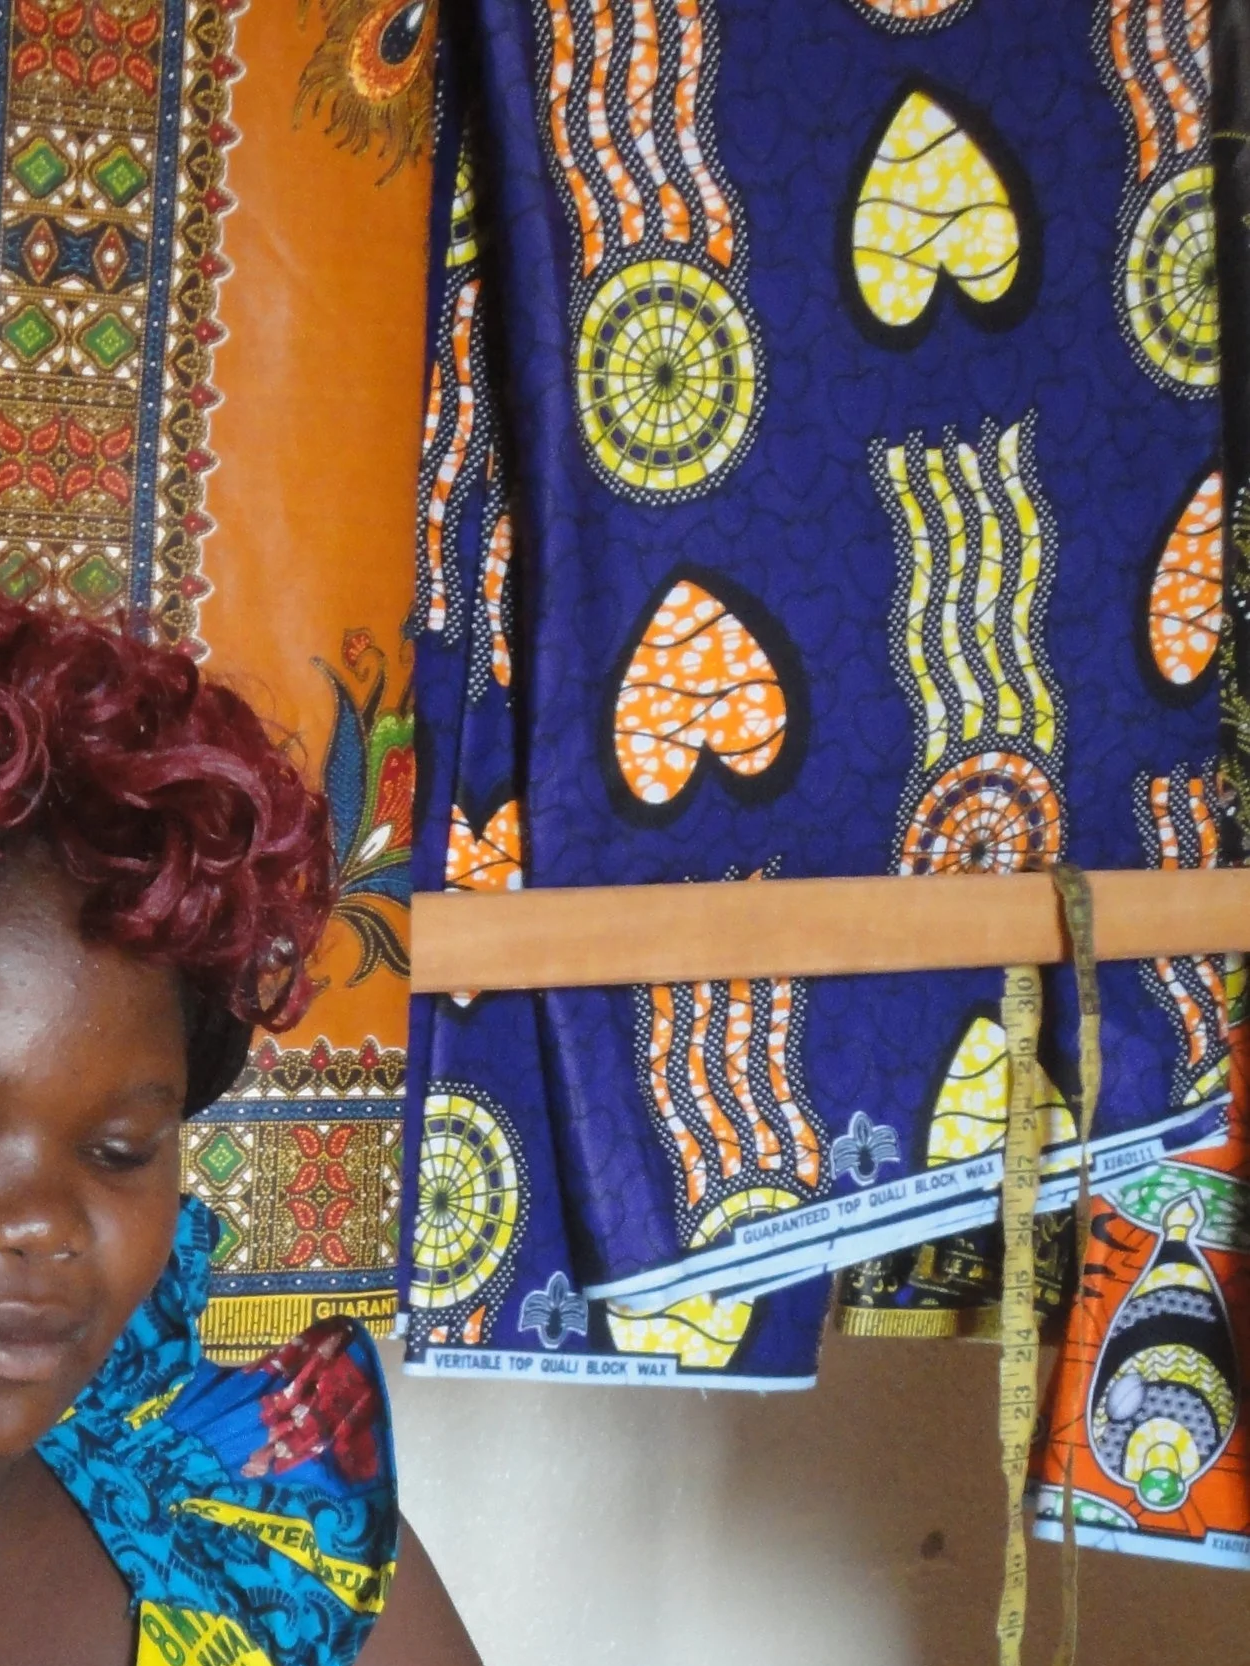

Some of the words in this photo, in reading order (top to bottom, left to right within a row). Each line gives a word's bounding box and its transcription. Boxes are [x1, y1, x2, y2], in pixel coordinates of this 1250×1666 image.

[743, 1206, 830, 1245] GUARANTEED
[837, 1198, 862, 1217] TOP
[869, 1184, 907, 1208] QUALI
[915, 1171, 958, 1195] BLOCK
[965, 1160, 995, 1180] WAX
[434, 1353, 500, 1370] VERITABLE
[508, 1355, 534, 1371] TOP
[540, 1357, 579, 1374] QUALI
[586, 1358, 628, 1376] BLOCK
[637, 1361, 668, 1377] WAX
